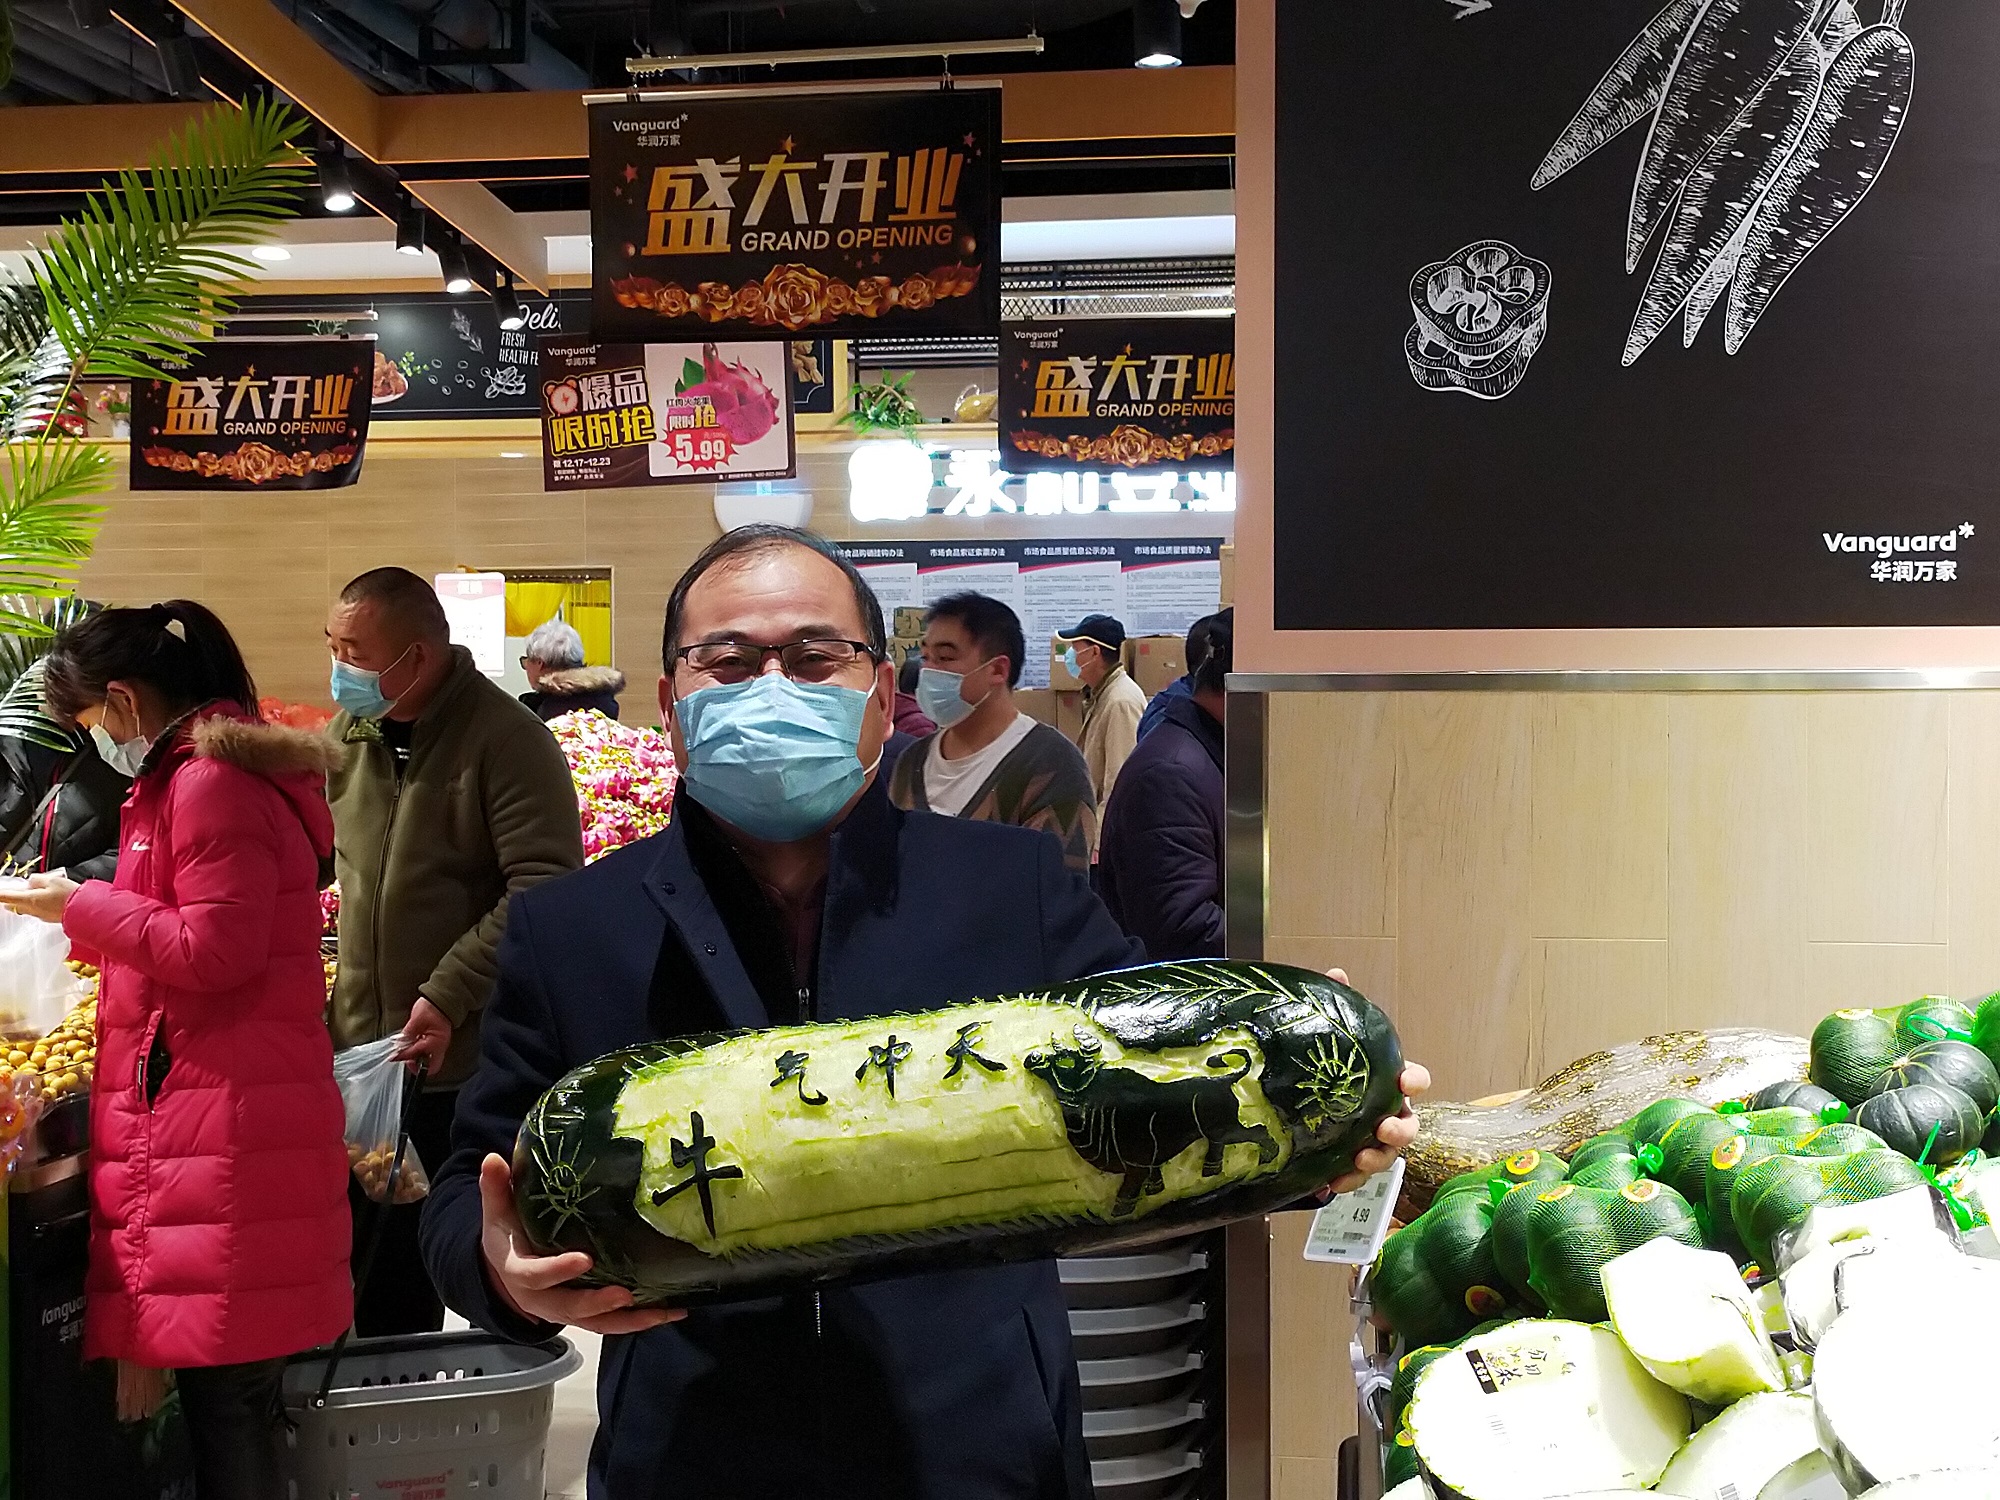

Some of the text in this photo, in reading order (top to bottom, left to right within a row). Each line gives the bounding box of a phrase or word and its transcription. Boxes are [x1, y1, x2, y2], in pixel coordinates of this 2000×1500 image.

[612, 116, 681, 134] Vanguard
[636, 134, 681, 147] 华润万家
[641, 147, 963, 256] 盛大开业
[741, 224, 953, 253] GRAND OPENING
[500, 331, 526, 347] FRESH
[1014, 328, 1059, 341] Vanguard
[498, 348, 529, 365] HEALTH
[547, 344, 596, 358] Vanguard
[578, 369, 648, 412] 爆品
[1030, 353, 1236, 418] 盛大开业
[162, 374, 354, 436] 盛大开业
[1096, 402, 1235, 418] GRAND OPENING
[223, 420, 346, 436] GRAND OPENING
[551, 405, 656, 453] 限时抢
[675, 433, 726, 462] 5.99
[1822, 529, 1958, 559] Vanguard
[1870, 560, 1958, 583] 华润万家
[652, 1021, 1008, 1240] 牛 气冲天
[1352, 1207, 1371, 1223] 4.99
